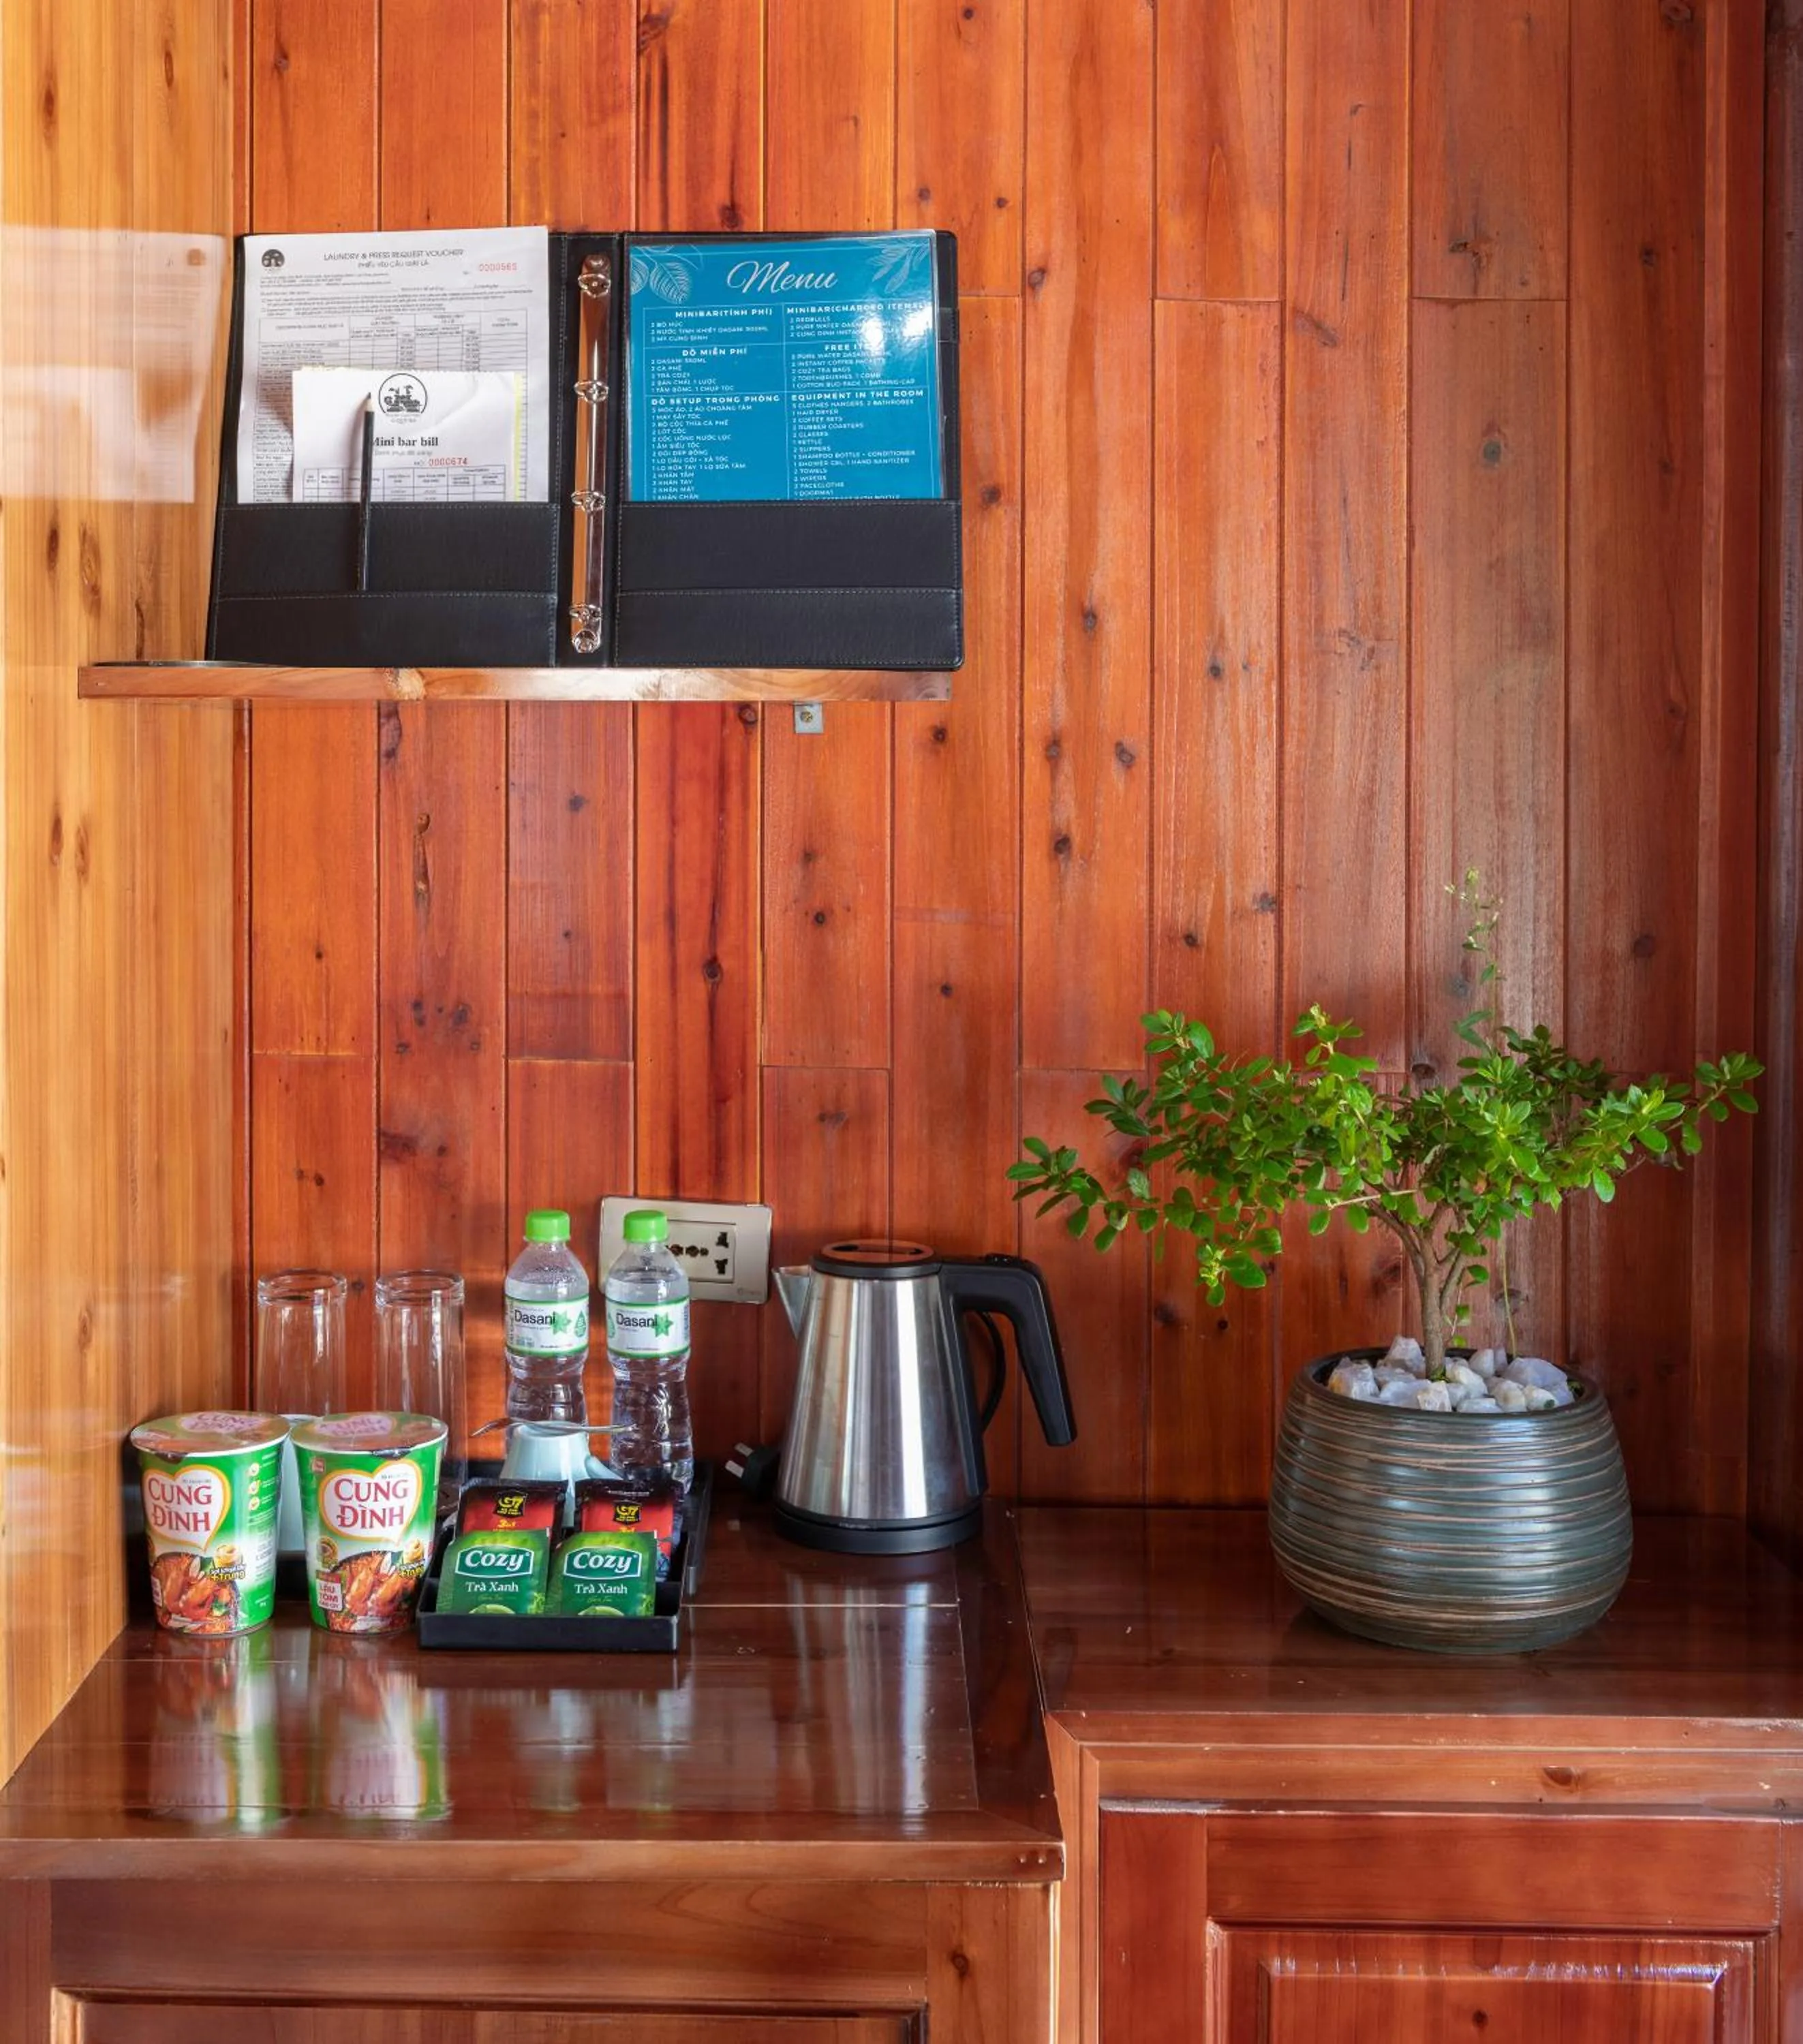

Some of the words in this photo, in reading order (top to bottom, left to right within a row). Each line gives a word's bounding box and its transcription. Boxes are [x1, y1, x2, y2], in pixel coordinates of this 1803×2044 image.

[324, 253, 359, 261] LAUNDRY
[392, 250, 423, 258] REQUEST
[425, 249, 464, 257] VOUCHER
[727, 260, 838, 294] Menu
[705, 396, 740, 404] TRONG
[791, 392, 851, 401] EQUIPMENT
[398, 436, 417, 446] bar
[420, 436, 438, 446] bill
[514, 1310, 555, 1325] Dasani
[617, 1312, 658, 1328] Dasani
[148, 1477, 212, 1505] CUNG
[334, 1478, 409, 1502] CUNG
[498, 1496, 524, 1509] G7
[152, 1502, 211, 1532] ĐÌNH
[336, 1503, 405, 1529] ĐÌNH
[616, 1505, 639, 1516] G7
[465, 1550, 524, 1572] Cozy
[572, 1551, 632, 1573] Cozy
[465, 1581, 487, 1592] Trà
[489, 1581, 519, 1592] Xanh
[574, 1584, 596, 1594] Trà
[598, 1583, 628, 1594] Xanh
